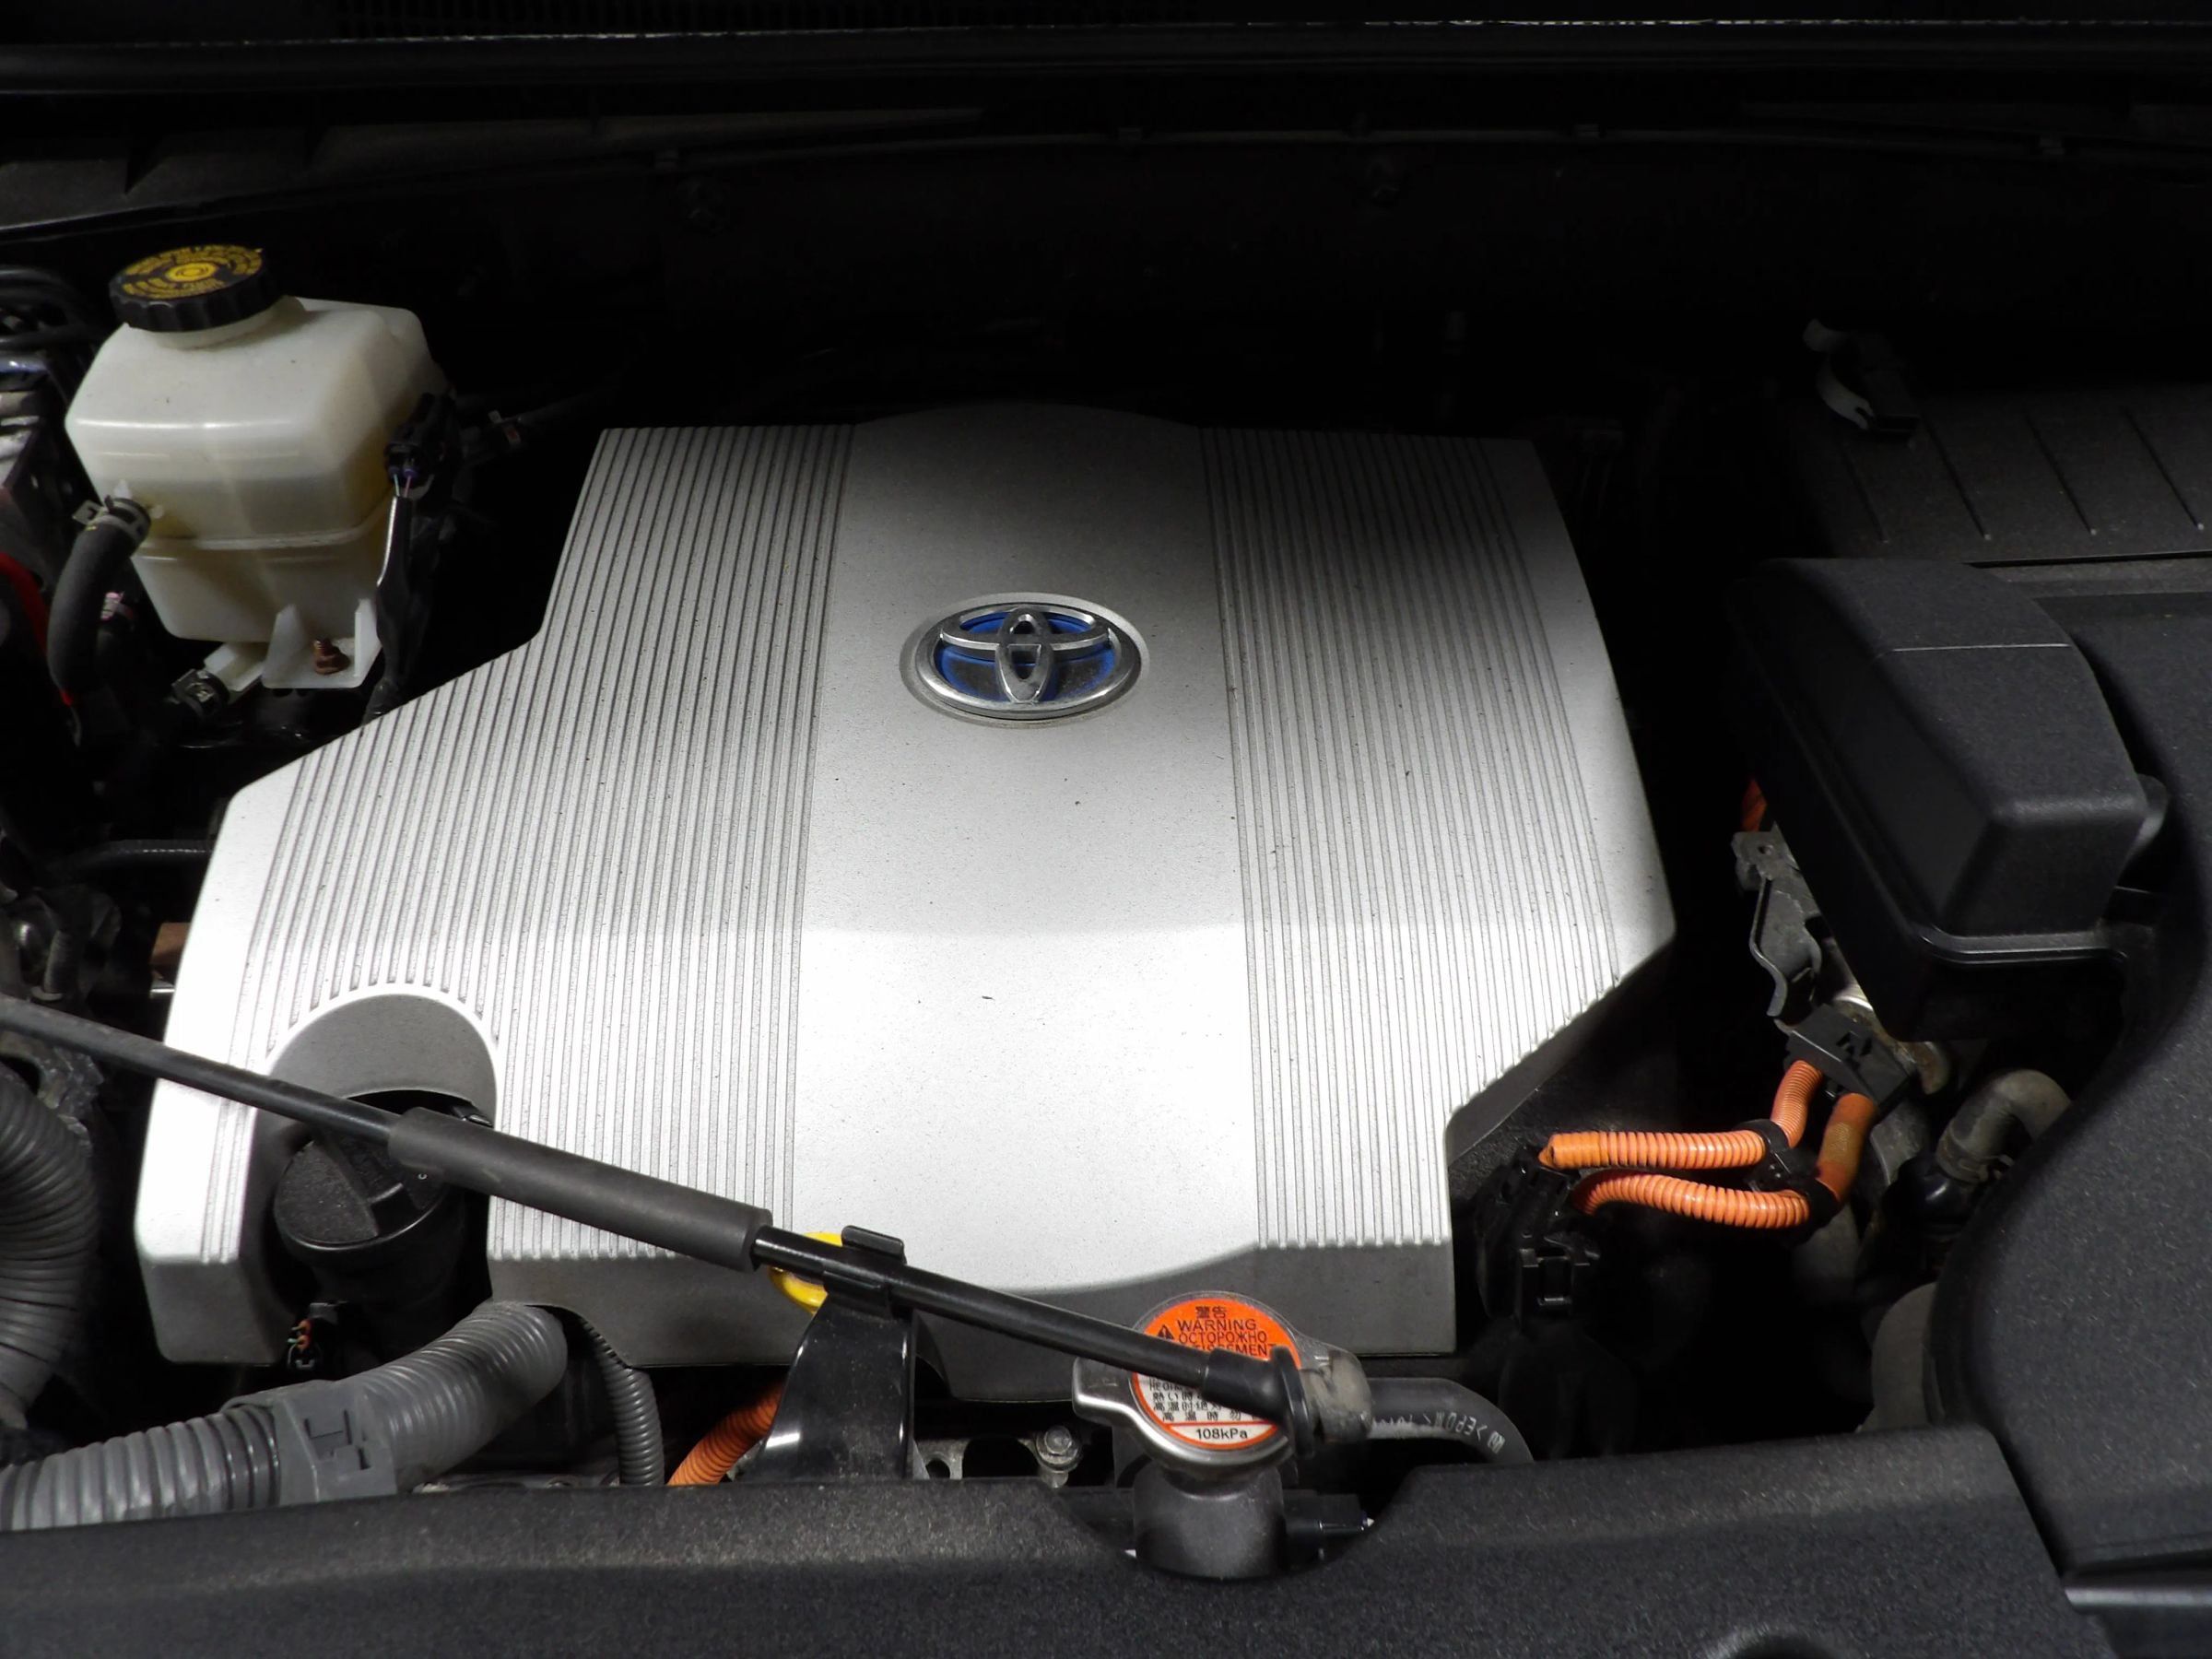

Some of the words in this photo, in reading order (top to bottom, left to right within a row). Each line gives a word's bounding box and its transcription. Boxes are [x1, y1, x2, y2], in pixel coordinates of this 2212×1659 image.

[1194, 1305, 1228, 1319] 警告
[1177, 1319, 1257, 1332] WARNING
[1178, 1330, 1268, 1345] ОСТОРОЖНО
[1195, 1428, 1248, 1441] 108kPa
